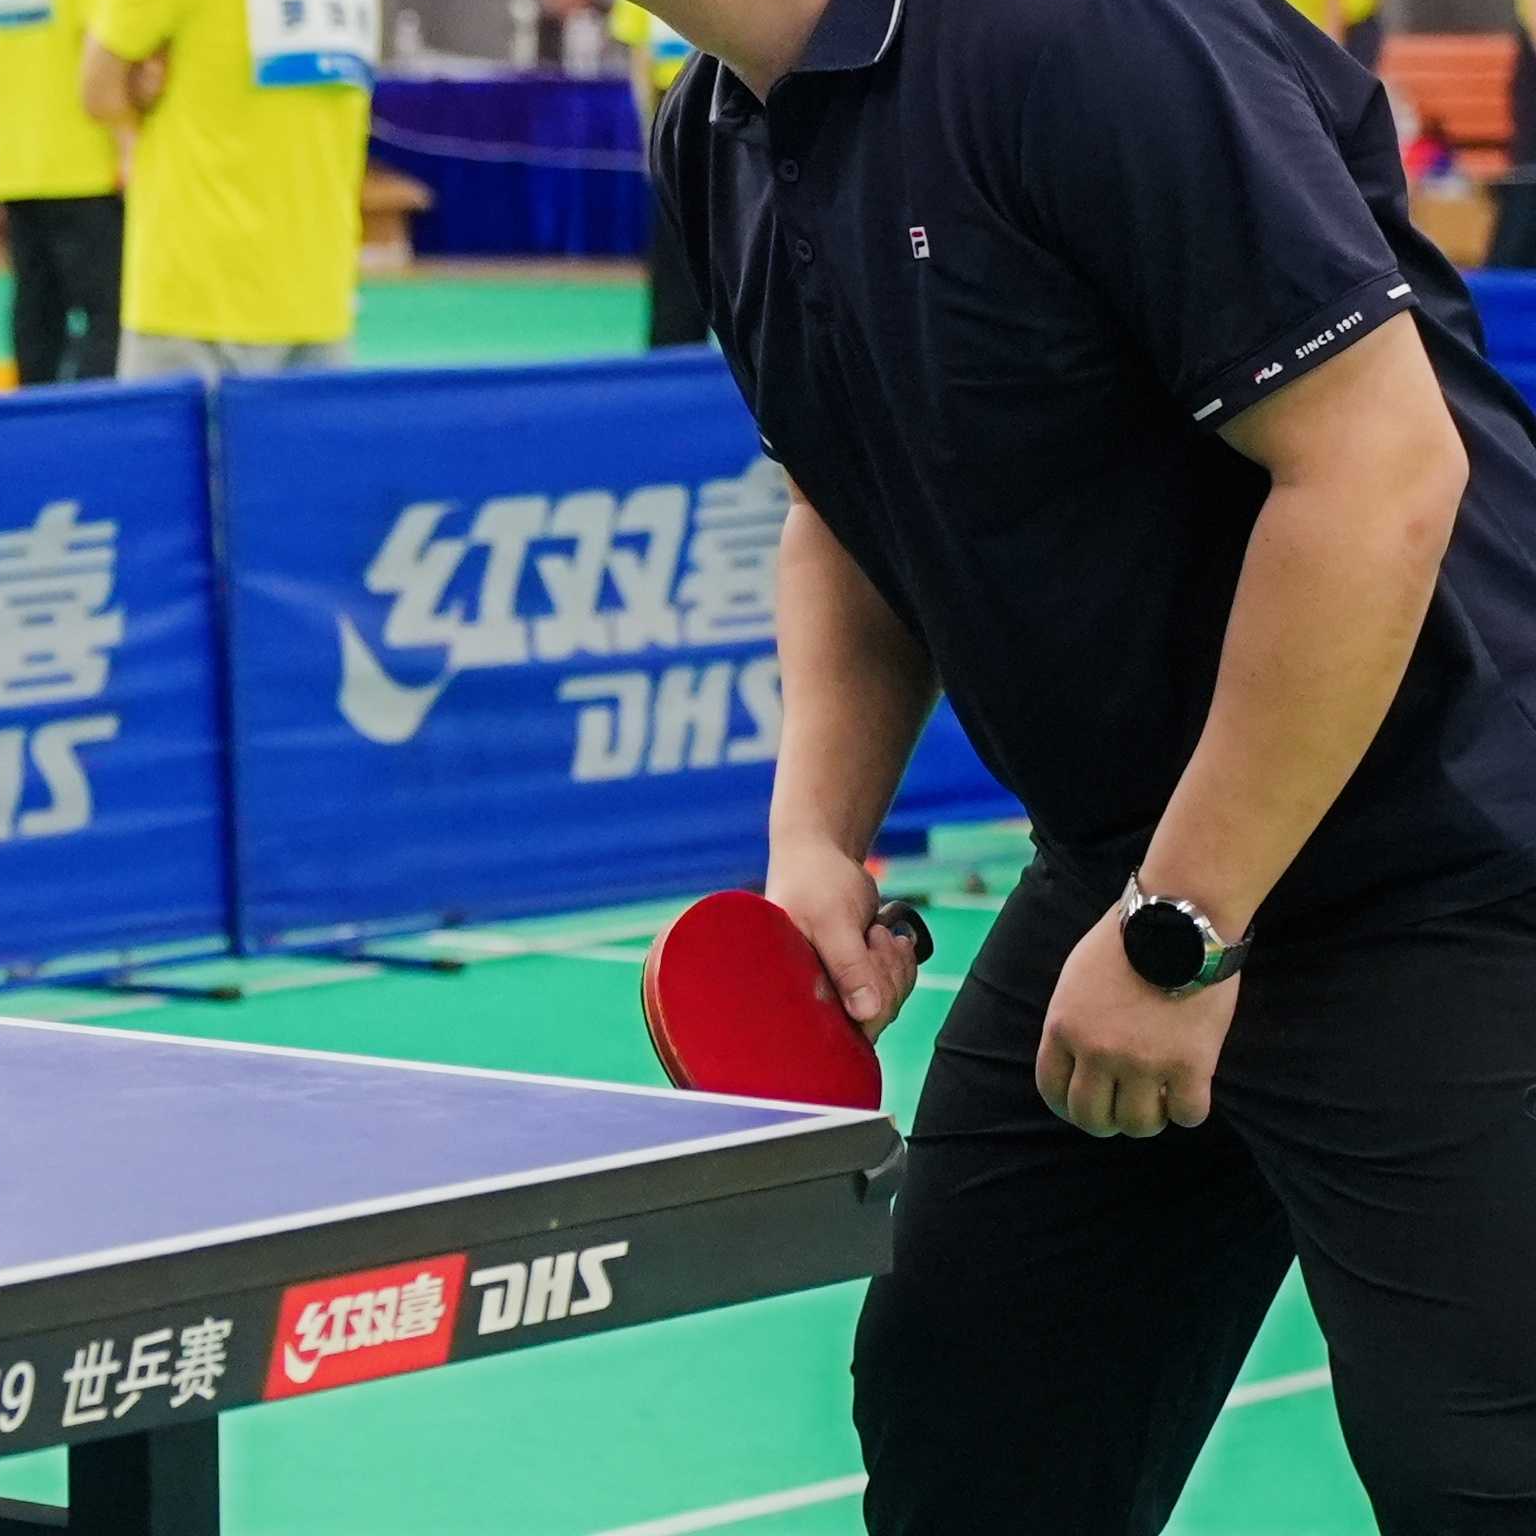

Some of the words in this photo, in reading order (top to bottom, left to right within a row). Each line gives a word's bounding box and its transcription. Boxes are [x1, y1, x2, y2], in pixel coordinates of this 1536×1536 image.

[1251, 361, 1284, 385] FILA
[1295, 329, 1336, 360] SINCE
[1335, 311, 1364, 334] 1911
[336, 453, 791, 746] 红双喜
[284, 1272, 446, 1384] 红双喜
[470, 1240, 629, 1336] DHS
[60, 1316, 233, 1428] 世乒赛
